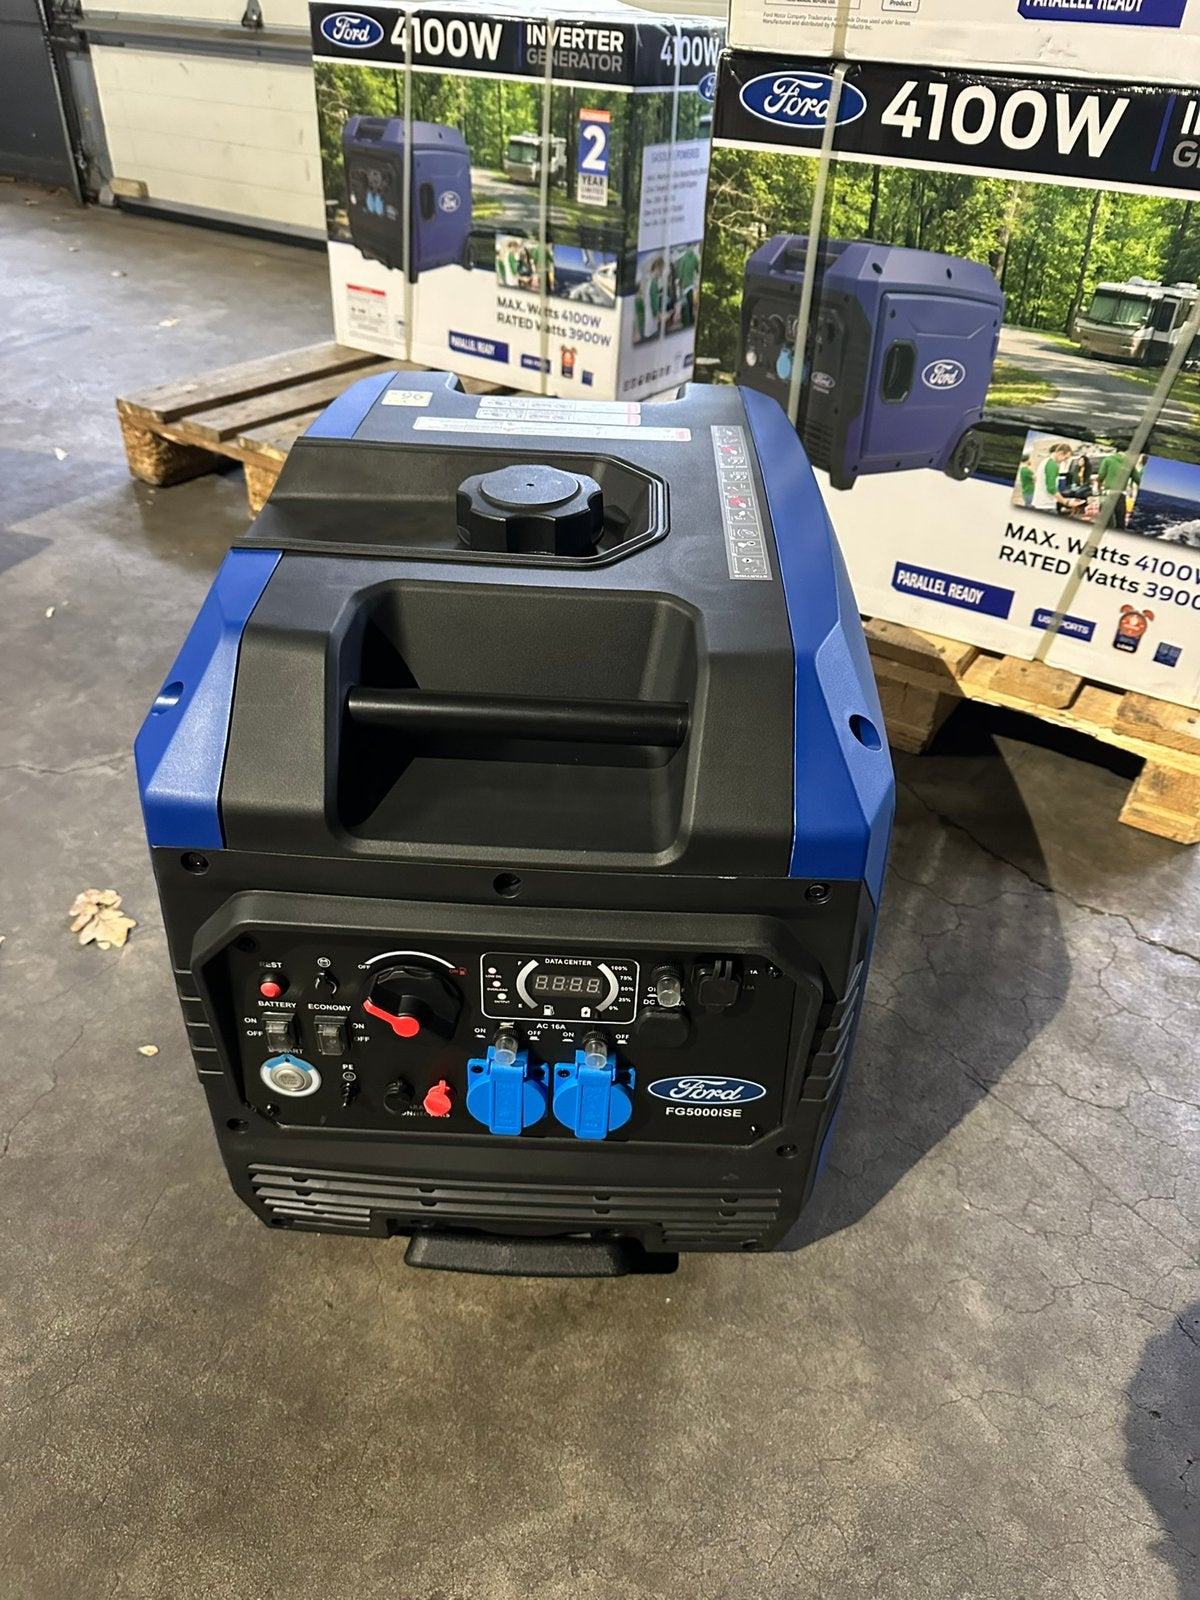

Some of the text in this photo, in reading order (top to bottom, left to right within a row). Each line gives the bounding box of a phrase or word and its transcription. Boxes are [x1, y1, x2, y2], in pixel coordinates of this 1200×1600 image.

[332, 15, 371, 42] Ford
[390, 15, 502, 61] 4100W
[526, 24, 625, 53] INVERTER
[526, 47, 623, 73] GENERATOR
[881, 80, 1130, 158] 4100W
[582, 124, 606, 171] 2
[927, 364, 958, 385] Ford
[1005, 522, 1060, 550] MAX.
[1068, 536, 1131, 566] Watts
[999, 545, 1071, 575] RATED
[896, 570, 984, 605] PARALLEL READY
[258, 1000, 297, 1009] BATTERY
[308, 1003, 351, 1012] ECONOMY
[669, 1078, 745, 1100] Ford
[665, 1106, 742, 1118] FG5000iSE
